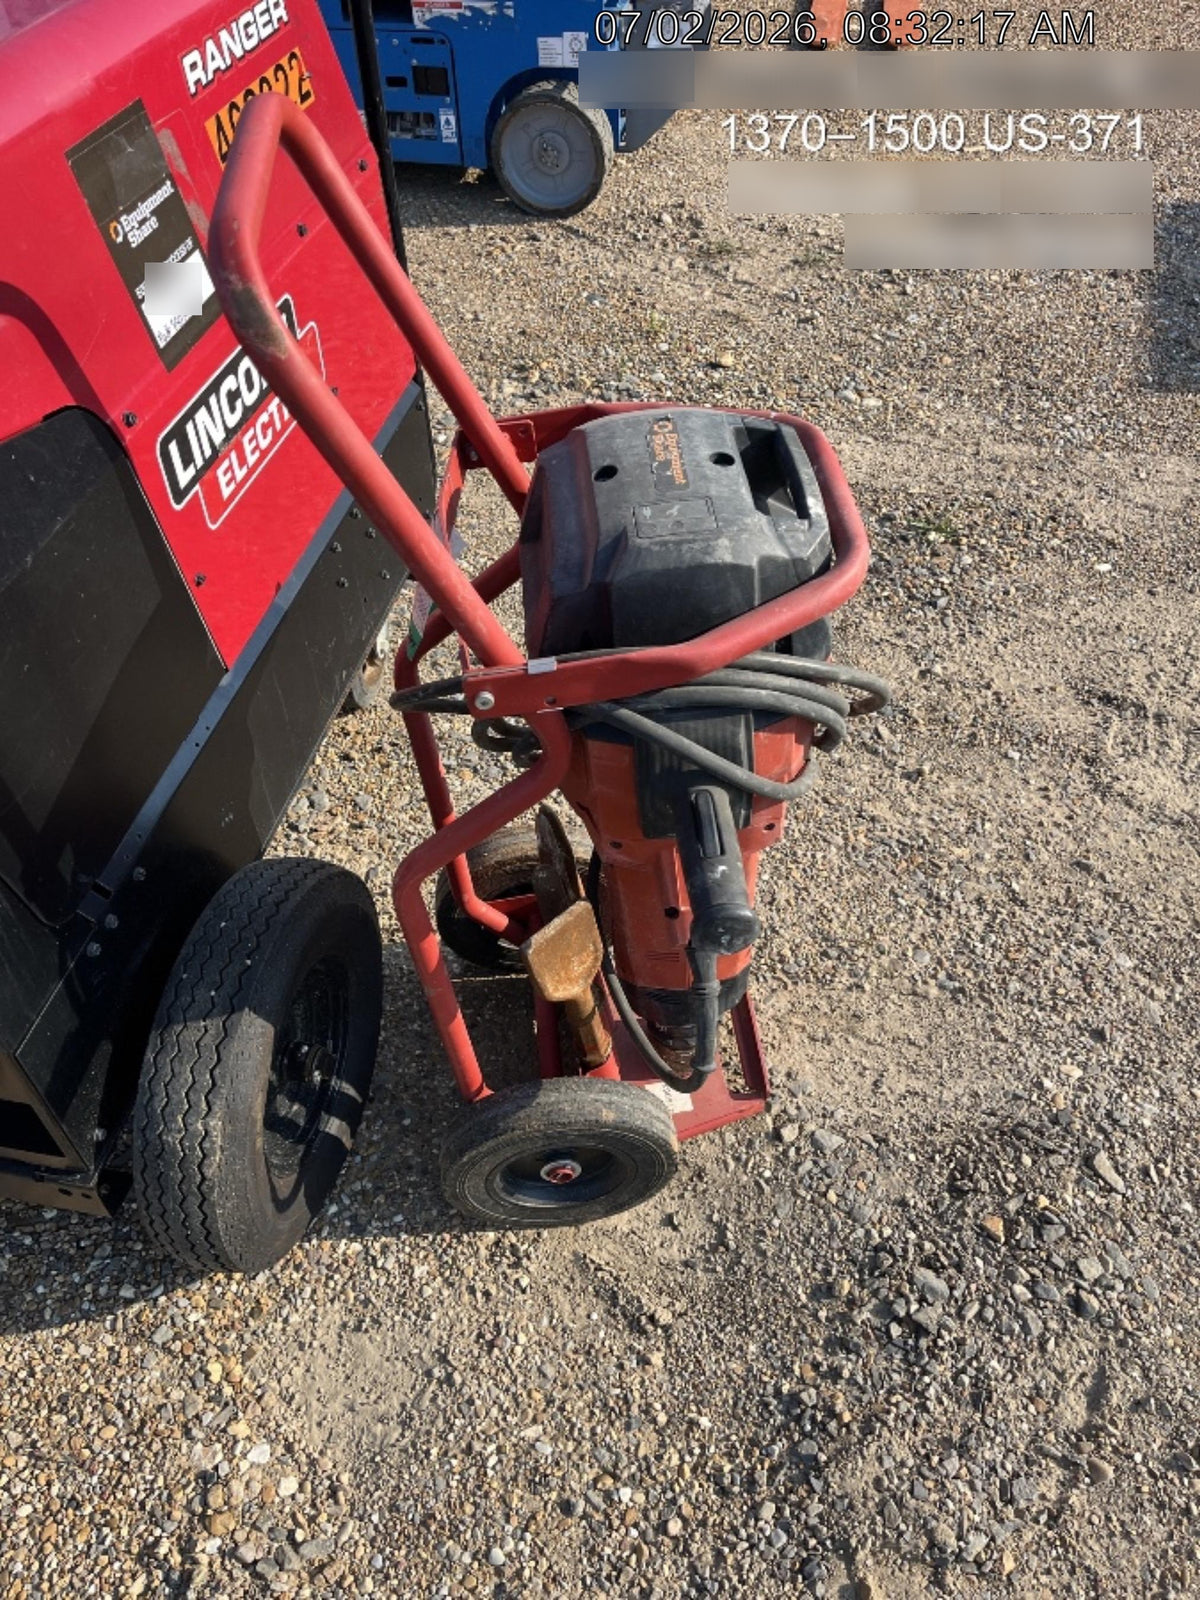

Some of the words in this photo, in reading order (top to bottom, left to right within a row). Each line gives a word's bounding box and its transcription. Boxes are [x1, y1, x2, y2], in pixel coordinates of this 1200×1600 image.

[182, 0, 289, 96] RANGER
[120, 179, 175, 232] Equipment
[127, 216, 159, 248] Share
